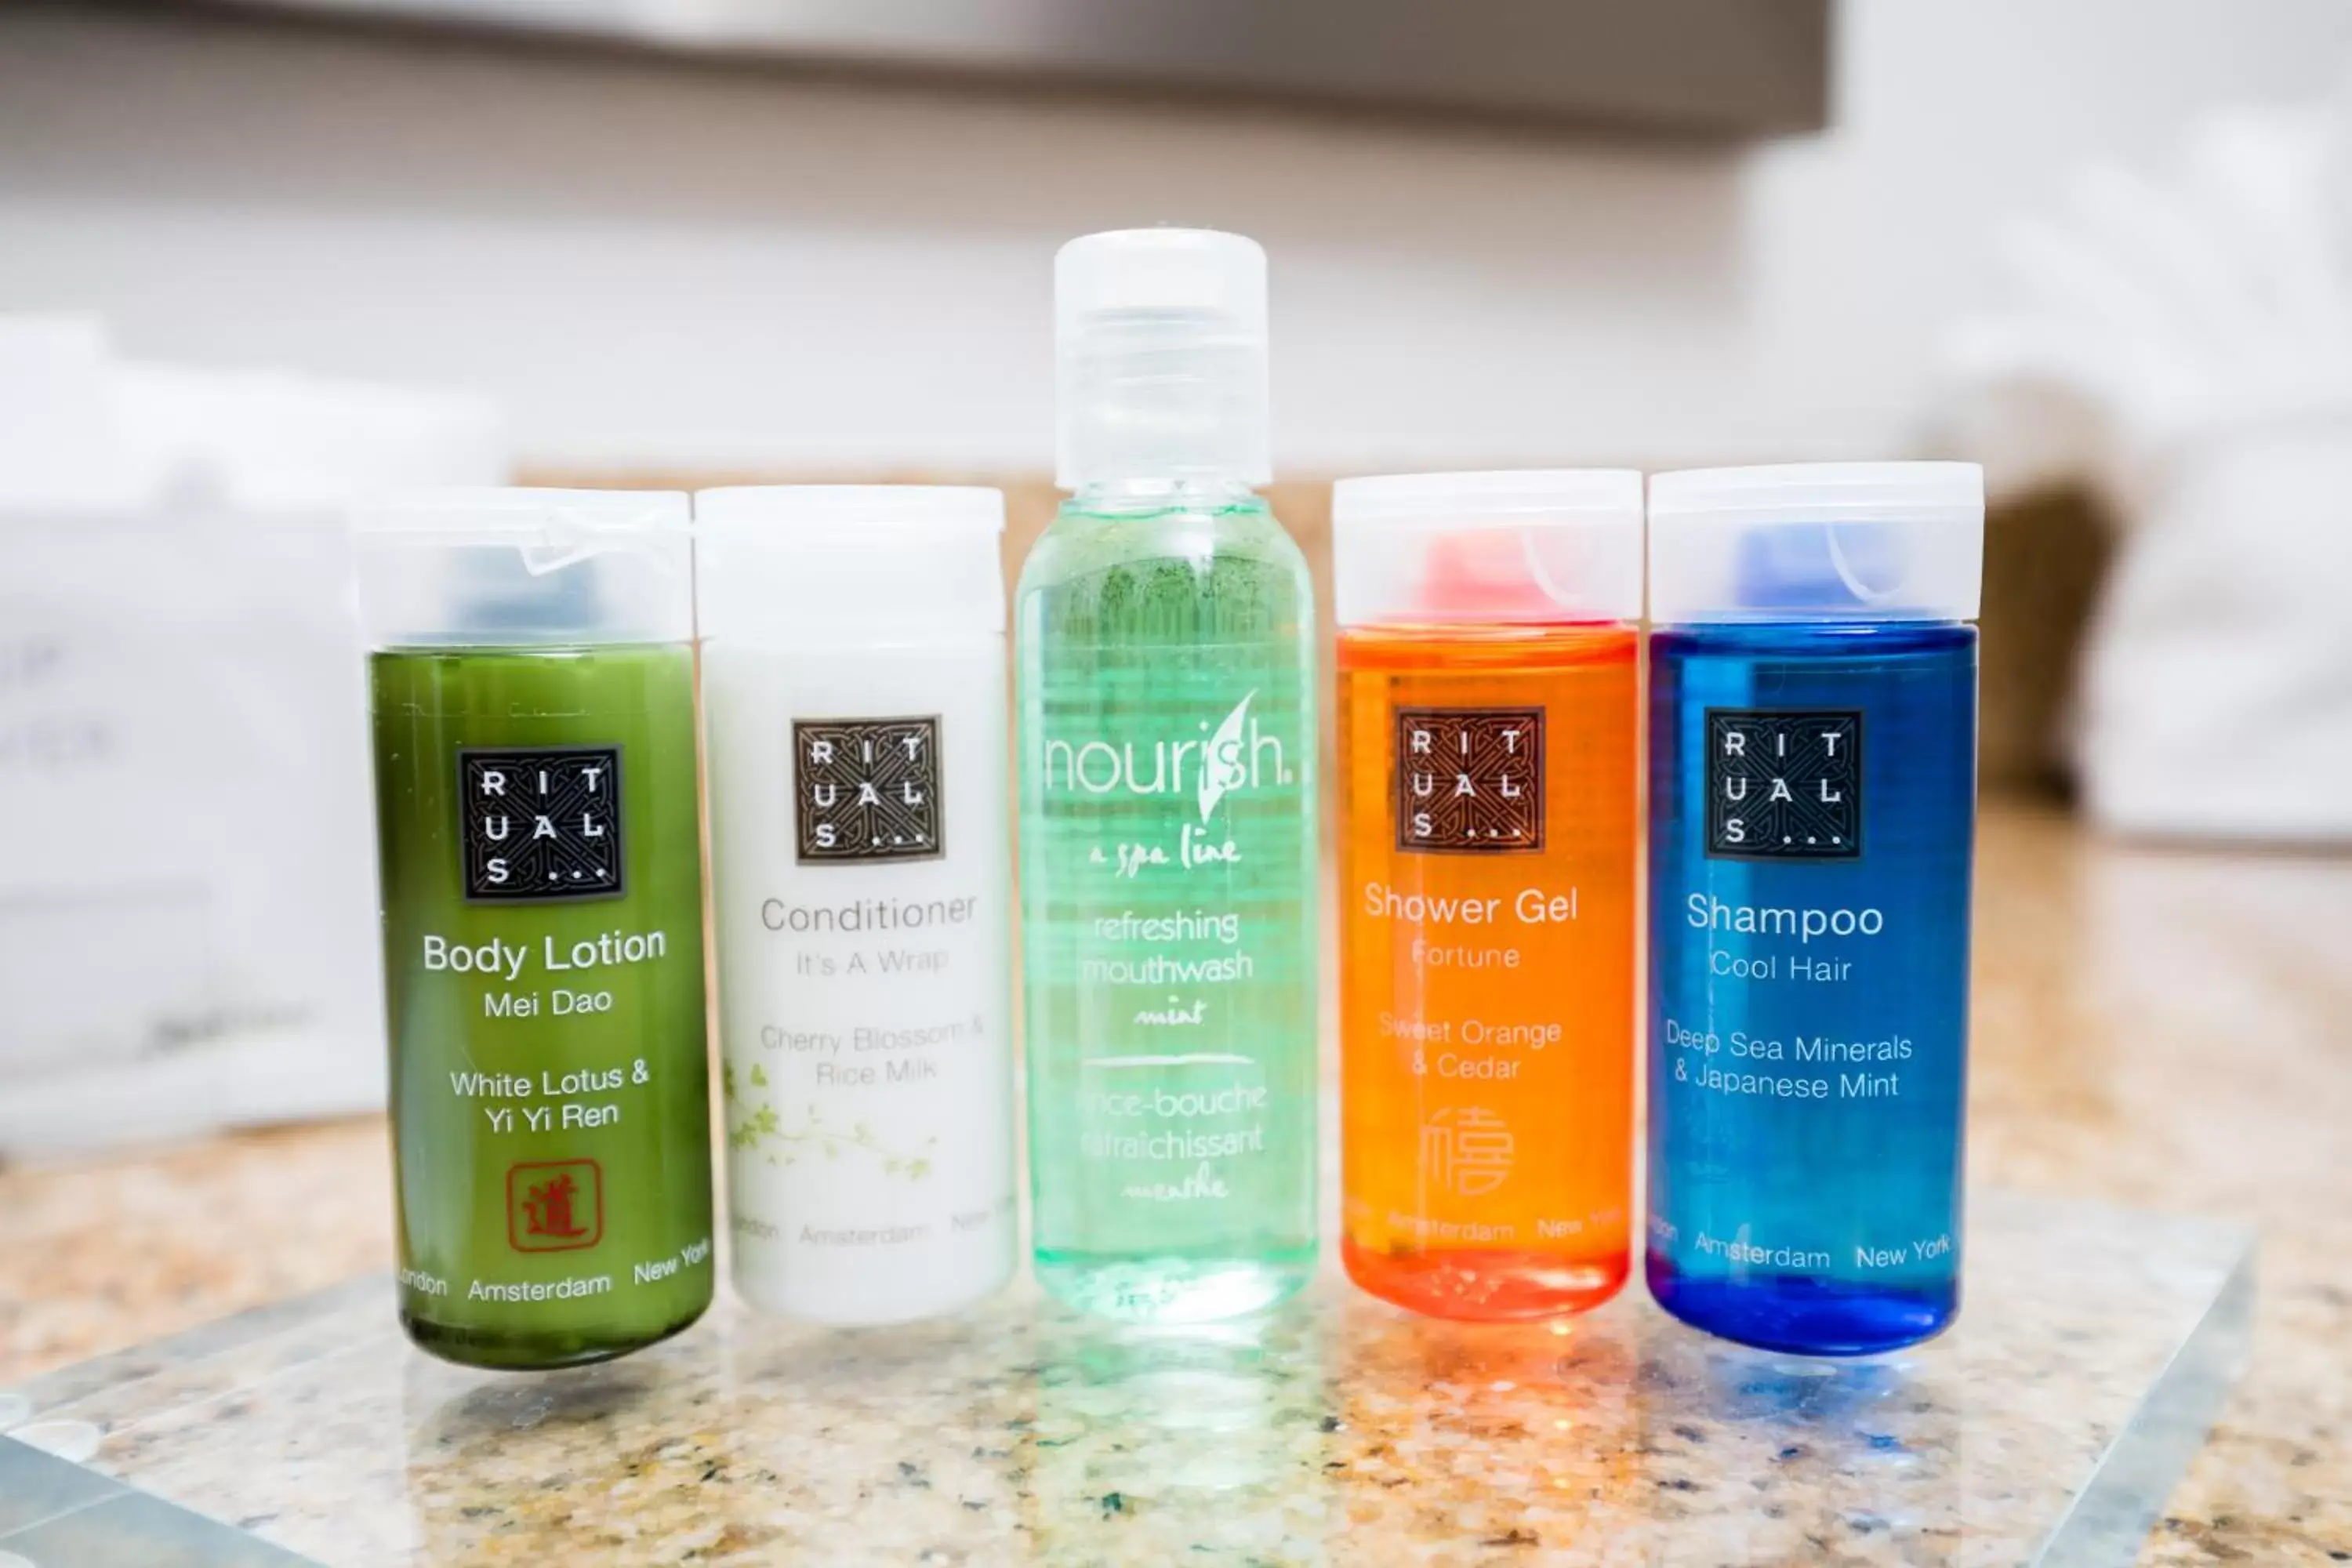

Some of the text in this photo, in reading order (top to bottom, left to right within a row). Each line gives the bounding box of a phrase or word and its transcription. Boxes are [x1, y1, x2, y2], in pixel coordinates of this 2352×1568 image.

[1091, 822, 1241, 878] a spa line
[761, 895, 976, 933] Conditioner
[1366, 882, 1577, 924] Shower Gel
[1688, 892, 1883, 943] Shampoo
[1094, 909, 1239, 943] refreshing
[424, 931, 666, 981] Body Lotion
[797, 947, 949, 977] It's A Wrap
[1081, 949, 1253, 985] mouthwash
[1412, 939, 1521, 968] Fortune
[1710, 950, 1853, 982] Cool Hair
[485, 990, 612, 1017] Mei Dao
[1134, 995, 1207, 1026] mint
[760, 1024, 842, 1056] Cherry
[854, 1022, 966, 1052] Blossom
[1379, 1011, 1562, 1050] Sweet Orange
[1667, 1018, 1912, 1062] Deep Sea Minerals
[450, 1059, 649, 1097] White Lotus &
[816, 1058, 938, 1087] Rice Milk
[1438, 1053, 1522, 1080] Cedar
[1675, 1058, 1899, 1099] & Japanese Mint
[485, 1103, 619, 1133] Yi Yi Ren
[1120, 1160, 1229, 1201] menthe
[1537, 1219, 1582, 1238] New
[1695, 1232, 1951, 1269] Amsterdam New York
[468, 1276, 613, 1301] Amsterdam
[635, 1258, 677, 1284] New
